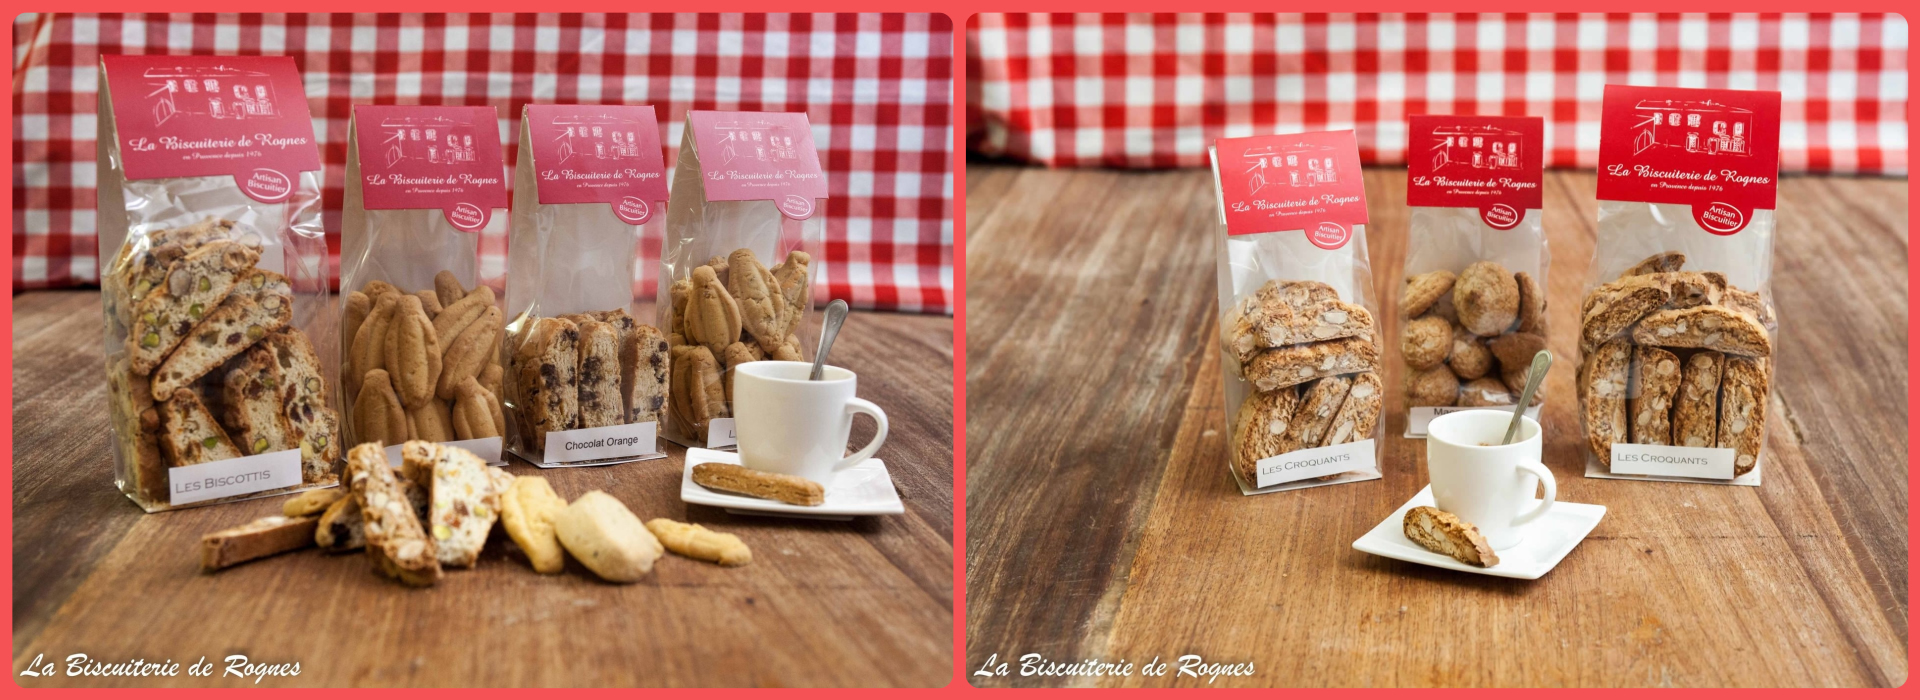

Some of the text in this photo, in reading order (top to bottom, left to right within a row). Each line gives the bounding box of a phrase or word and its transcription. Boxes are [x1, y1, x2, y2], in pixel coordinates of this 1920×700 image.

[129, 134, 308, 152] La Biscuiterie de Rognes
[252, 173, 281, 184] Artisan
[367, 174, 498, 187] La Biscuiterie de Rognes
[542, 169, 660, 181] La Biscuiterie de Rognes
[708, 170, 818, 181] La Biscuiterie de Rognes
[1607, 164, 1771, 187] La Biscuiterie de Rognes
[247, 180, 286, 193] Biscuitier
[1413, 176, 1537, 191] La Biscuiterie de Rognes
[1659, 182, 1687, 190] Provence
[623, 200, 642, 208] Artisan
[1232, 194, 1360, 212] La Biscuiterie de Rognes
[456, 206, 477, 216] Artisan
[619, 205, 645, 216] Biscuitier
[1492, 207, 1512, 216] Artisan
[1709, 205, 1736, 218] Artisan
[451, 211, 480, 223] Biscuitier
[1487, 211, 1514, 223] Biscuitier
[1703, 211, 1738, 227] Biscuitier
[1319, 225, 1340, 233] Artisan
[1314, 232, 1342, 240] Biscuitier
[565, 436, 638, 451] Chocolat Orange
[1262, 454, 1350, 475] LES CROQUANTS
[1617, 453, 1708, 465] LES CROQUANTS
[175, 470, 271, 494] LES BISCOTTIS
